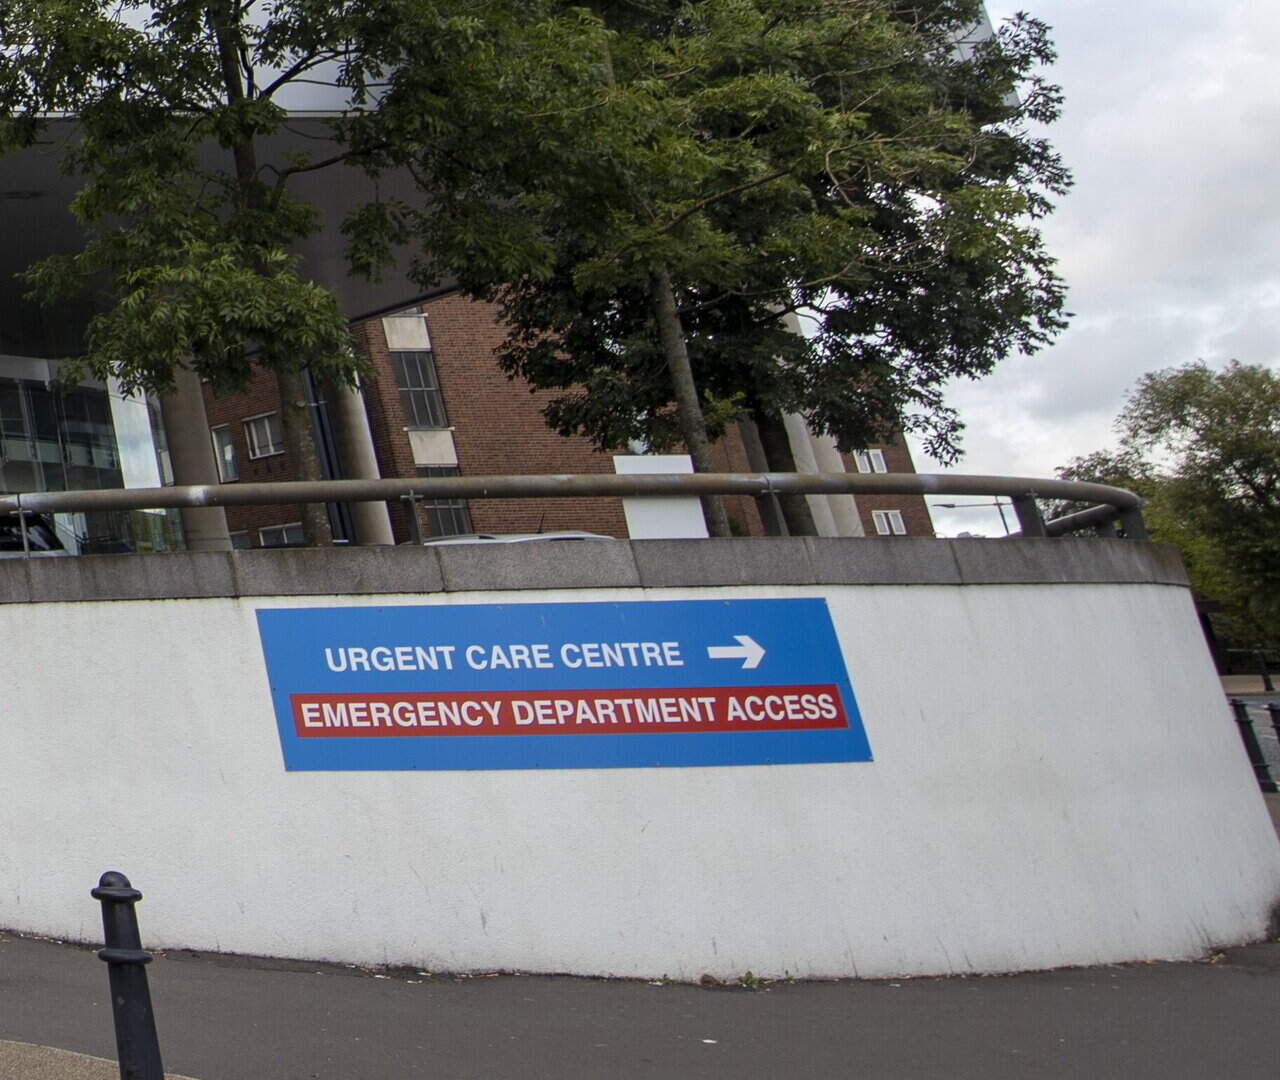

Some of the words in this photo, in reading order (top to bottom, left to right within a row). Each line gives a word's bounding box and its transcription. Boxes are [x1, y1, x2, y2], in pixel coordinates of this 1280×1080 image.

[325, 646, 455, 672] URGENT
[465, 644, 554, 670] CARE
[560, 642, 684, 668] CENTRE
[301, 701, 501, 728] EMERGENCY
[511, 697, 716, 725] DEPARTMENT
[727, 693, 837, 721] ACCESS
